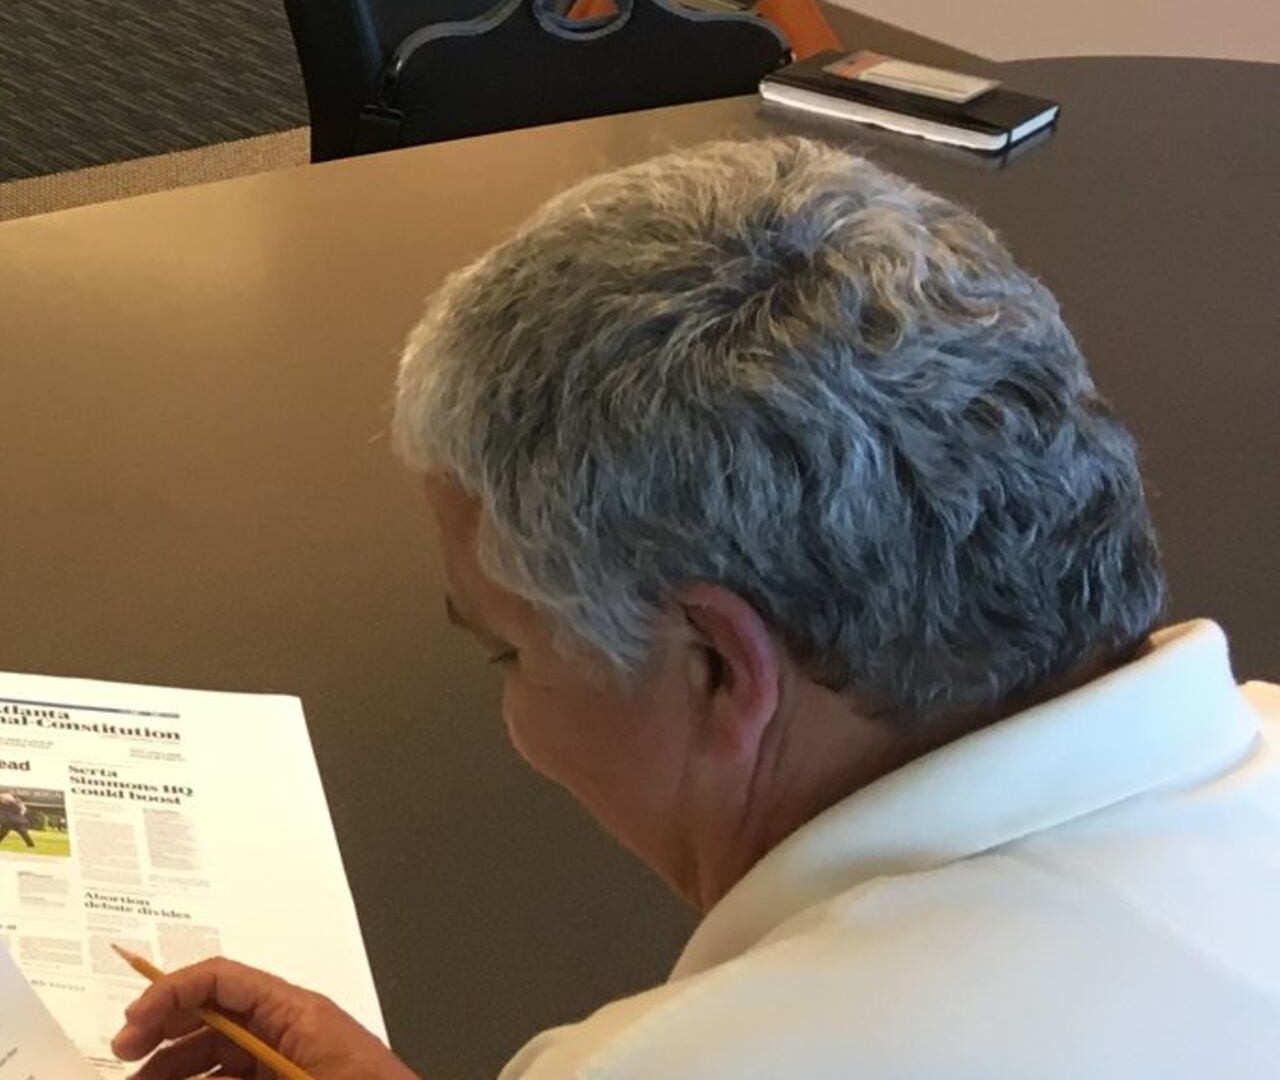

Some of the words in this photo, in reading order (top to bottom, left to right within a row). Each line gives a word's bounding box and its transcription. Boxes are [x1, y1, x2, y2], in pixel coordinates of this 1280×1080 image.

[68, 764, 118, 778] Serta
[69, 775, 158, 792] Simmons
[162, 784, 194, 797] HQ
[70, 787, 125, 799] could
[129, 790, 181, 805] boost
